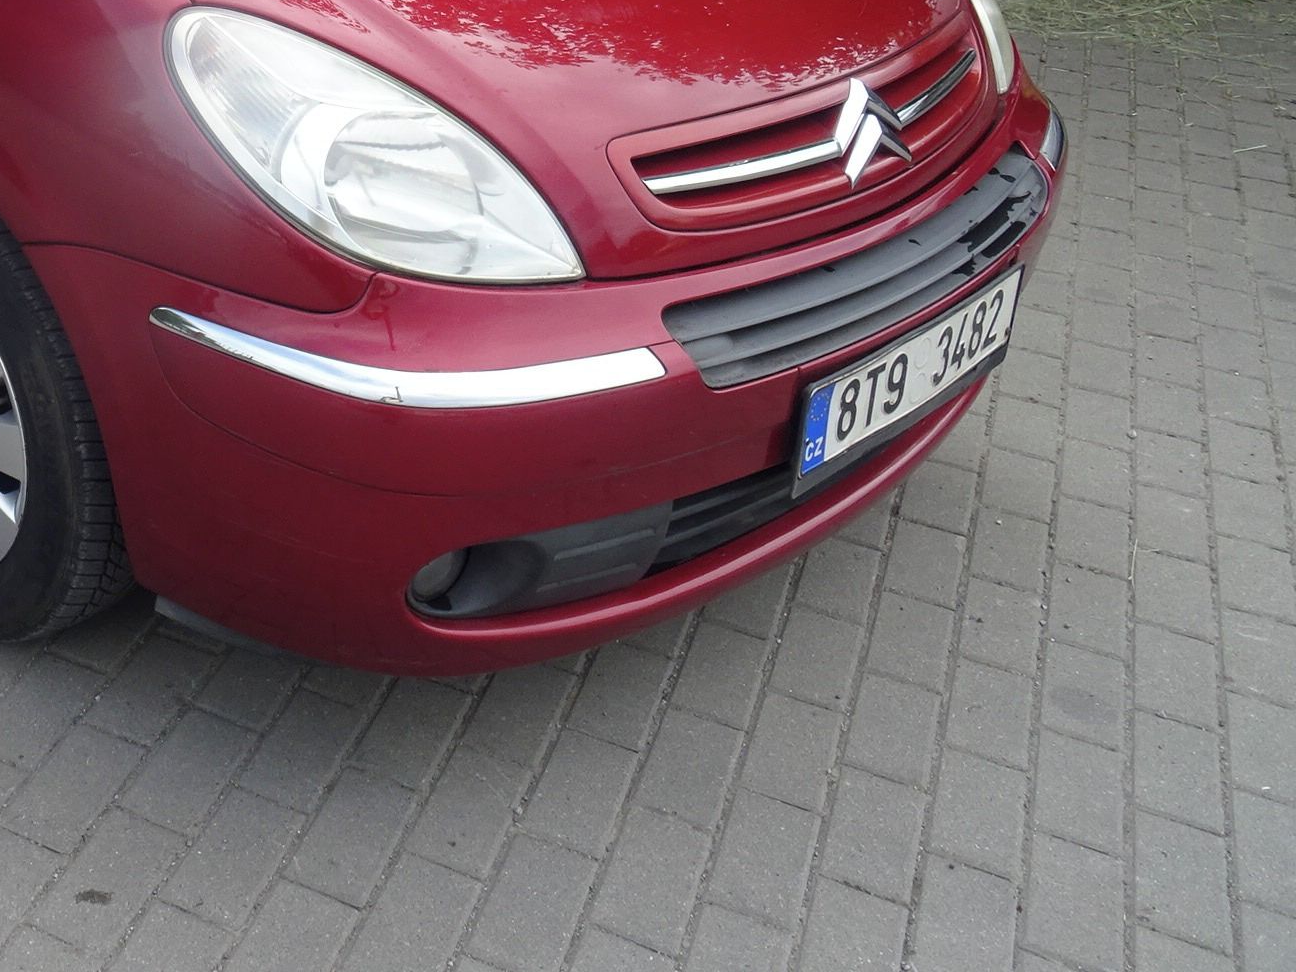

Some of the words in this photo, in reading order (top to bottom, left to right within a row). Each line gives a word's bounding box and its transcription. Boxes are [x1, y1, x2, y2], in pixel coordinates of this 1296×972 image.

[836, 353, 909, 441] 8T9
[932, 289, 1004, 387] 3482
[805, 436, 824, 462] CZ
